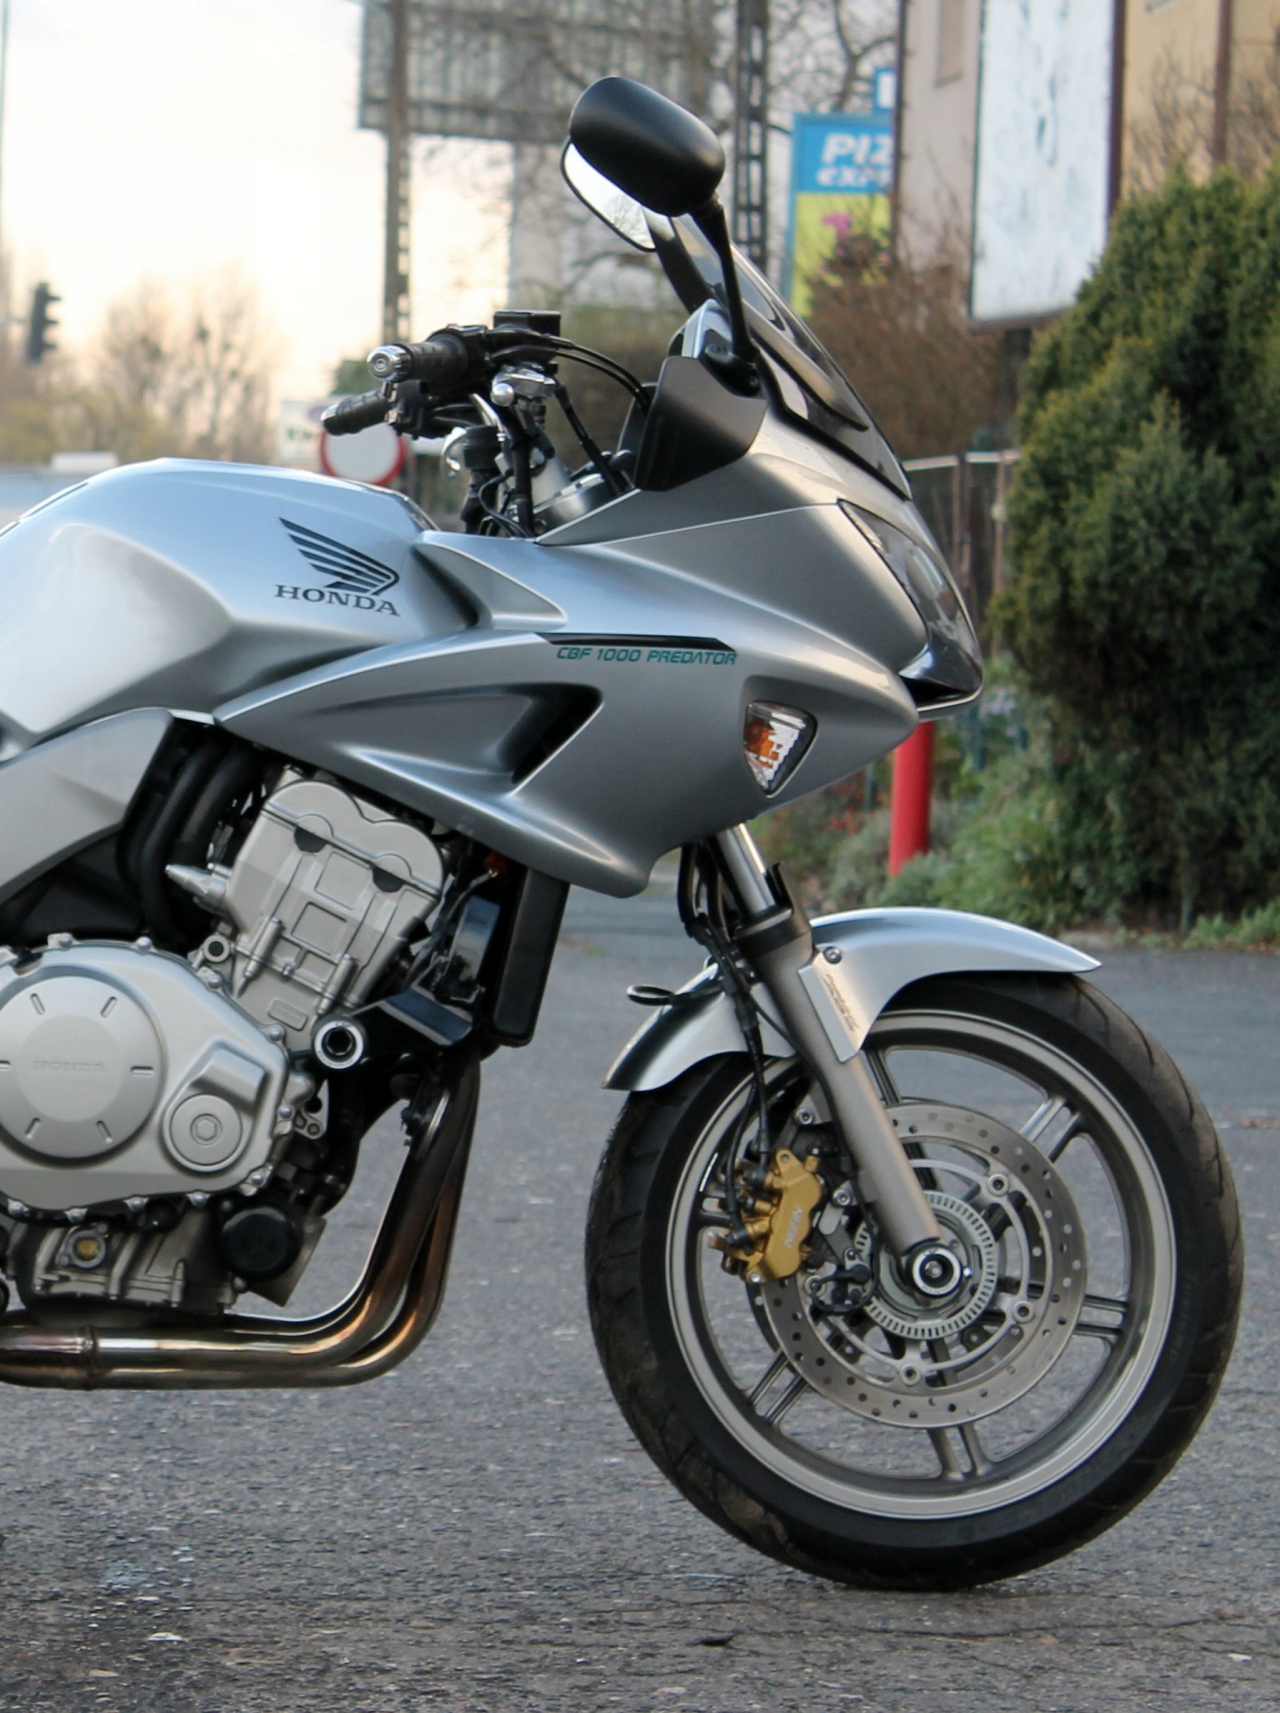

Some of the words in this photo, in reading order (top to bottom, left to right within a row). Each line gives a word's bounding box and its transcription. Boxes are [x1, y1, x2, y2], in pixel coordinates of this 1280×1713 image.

[274, 584, 401, 617] HONDA
[556, 646, 593, 660] CBF
[596, 648, 642, 663] 1000
[646, 650, 738, 666] PREDATOR
[32, 1060, 108, 1074] HONDA
